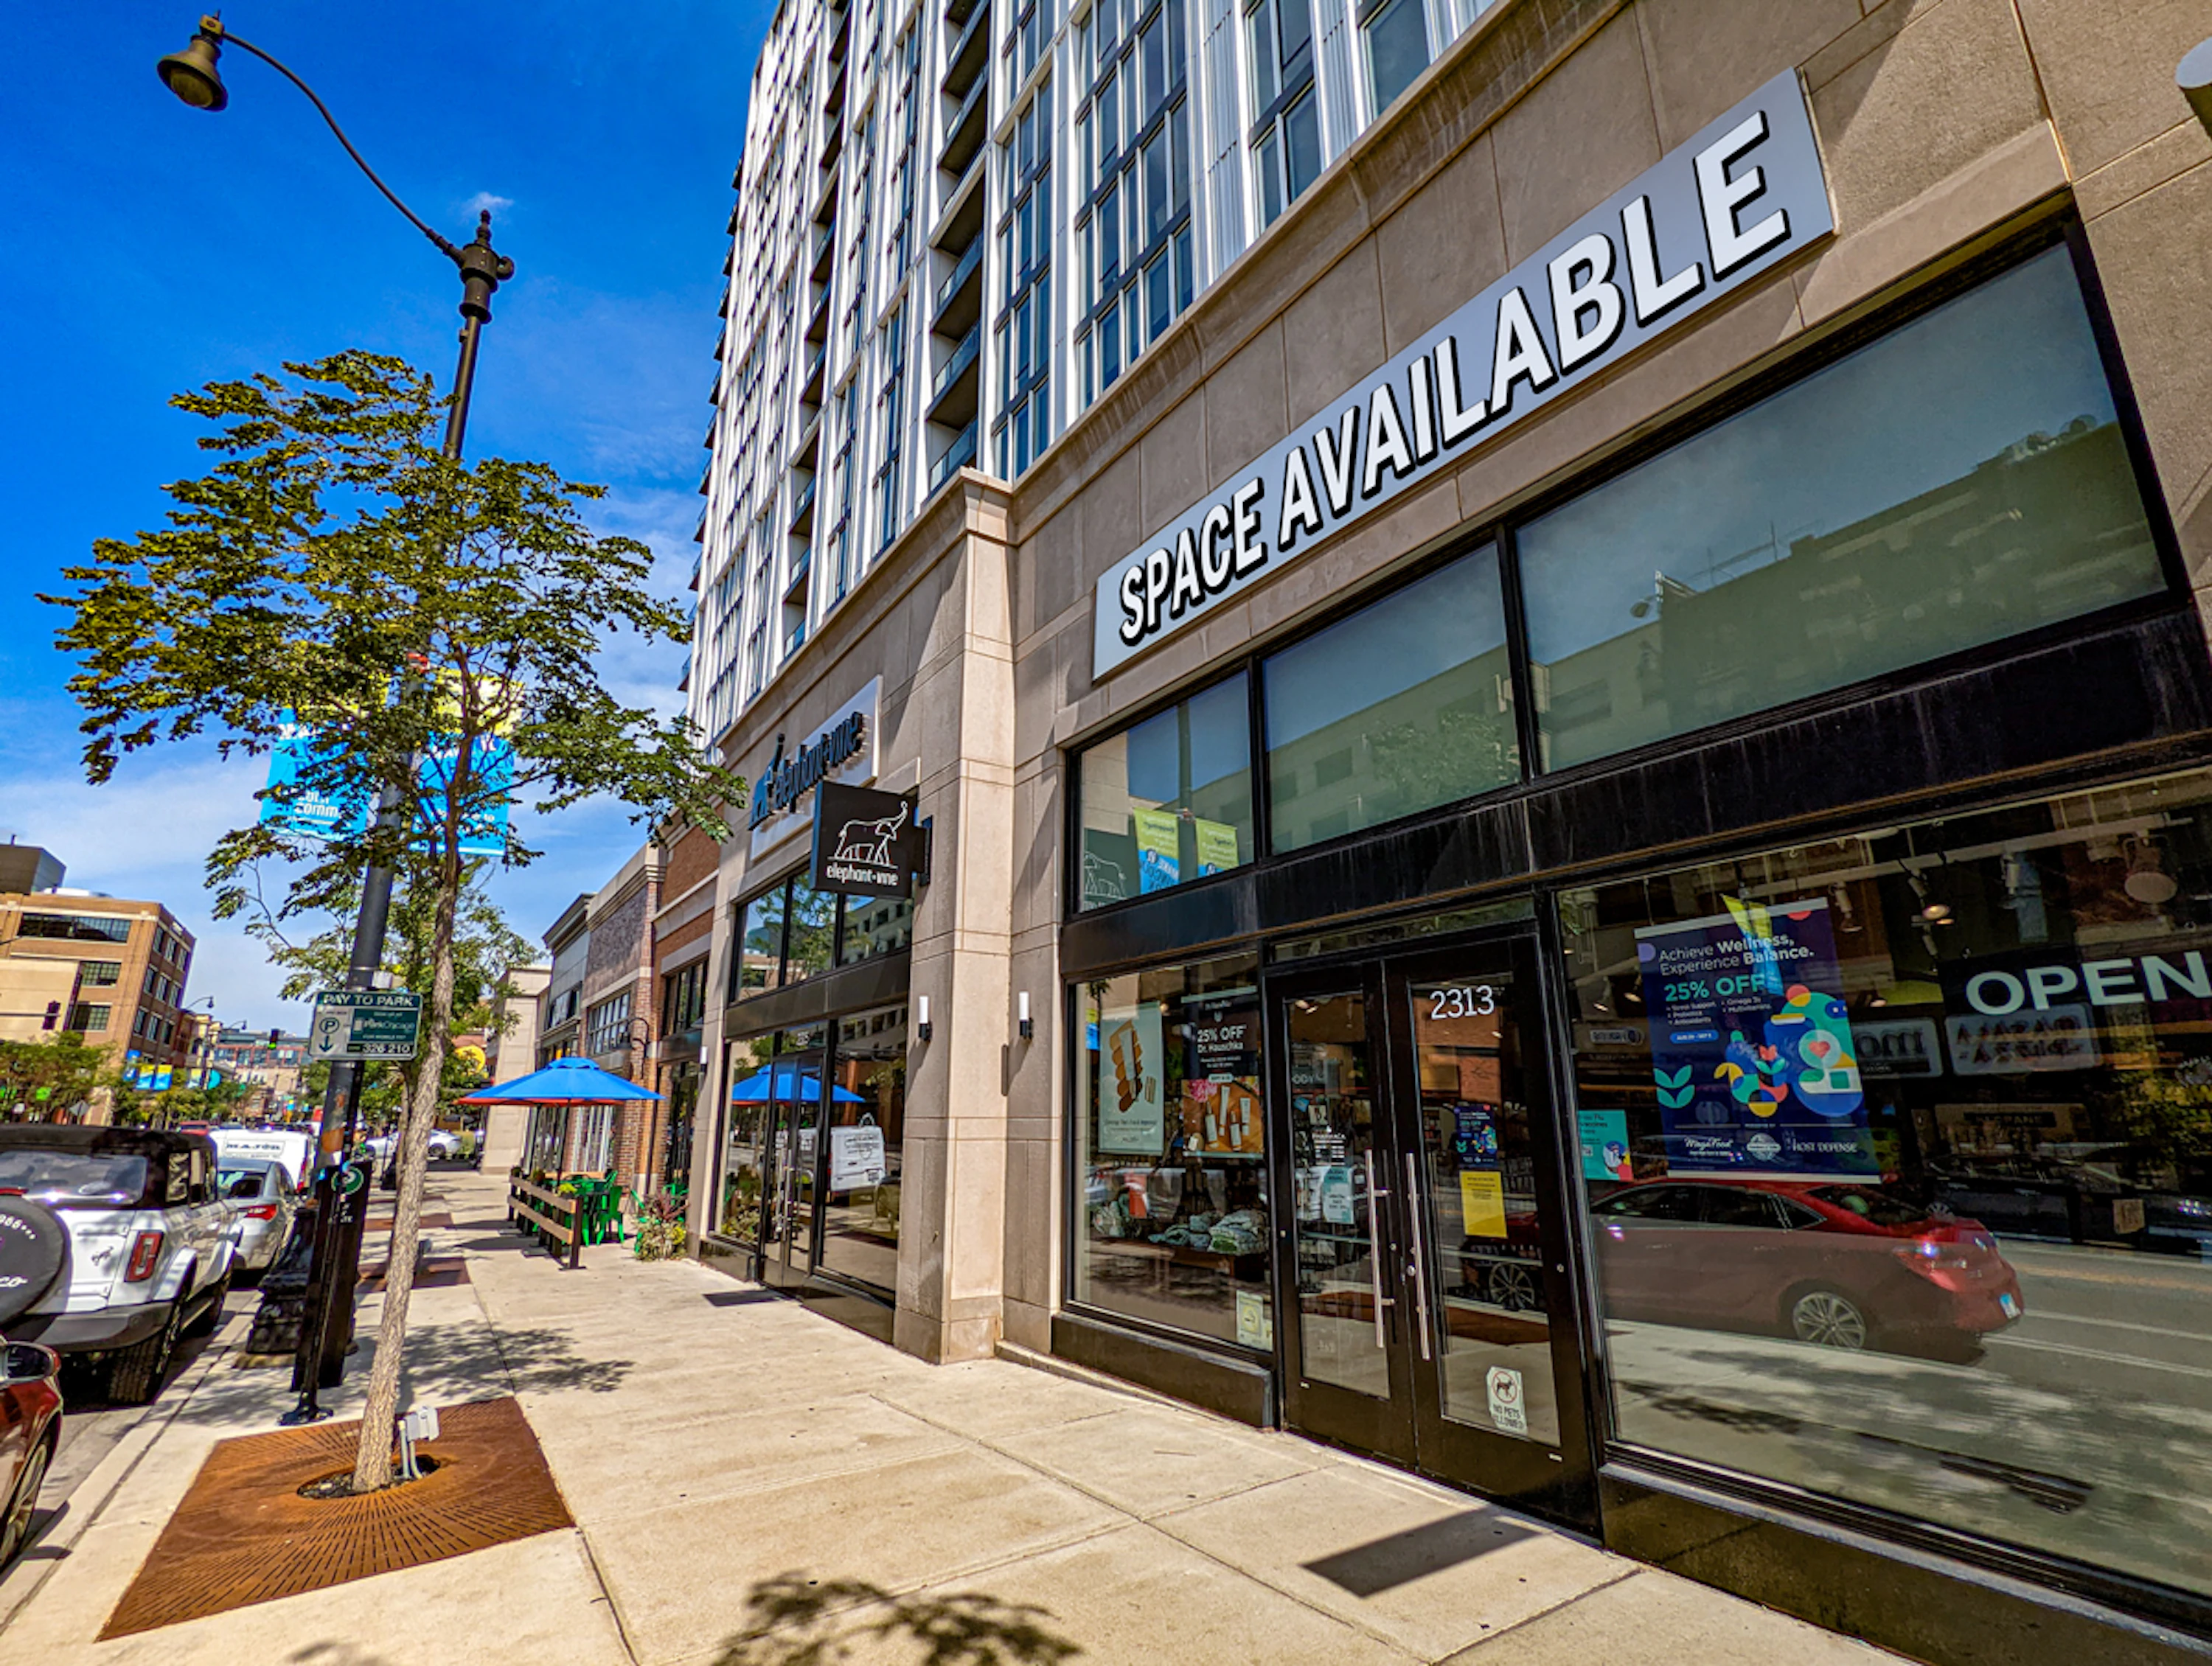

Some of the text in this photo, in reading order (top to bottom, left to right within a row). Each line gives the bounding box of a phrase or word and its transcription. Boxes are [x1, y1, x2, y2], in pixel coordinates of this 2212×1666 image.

[1119, 110, 1790, 646] SPACE AVAILABLE
[1660, 934, 1795, 961] Achieve Wellness,
[1660, 945, 1815, 976] Experience Balance.
[1664, 974, 1765, 1002] 25% OFF
[1966, 951, 2212, 1015] OPEN
[324, 994, 414, 1005] PAY TO PARK
[1430, 985, 1495, 1020] 2313
[1197, 1025, 1247, 1042] 25% OFF
